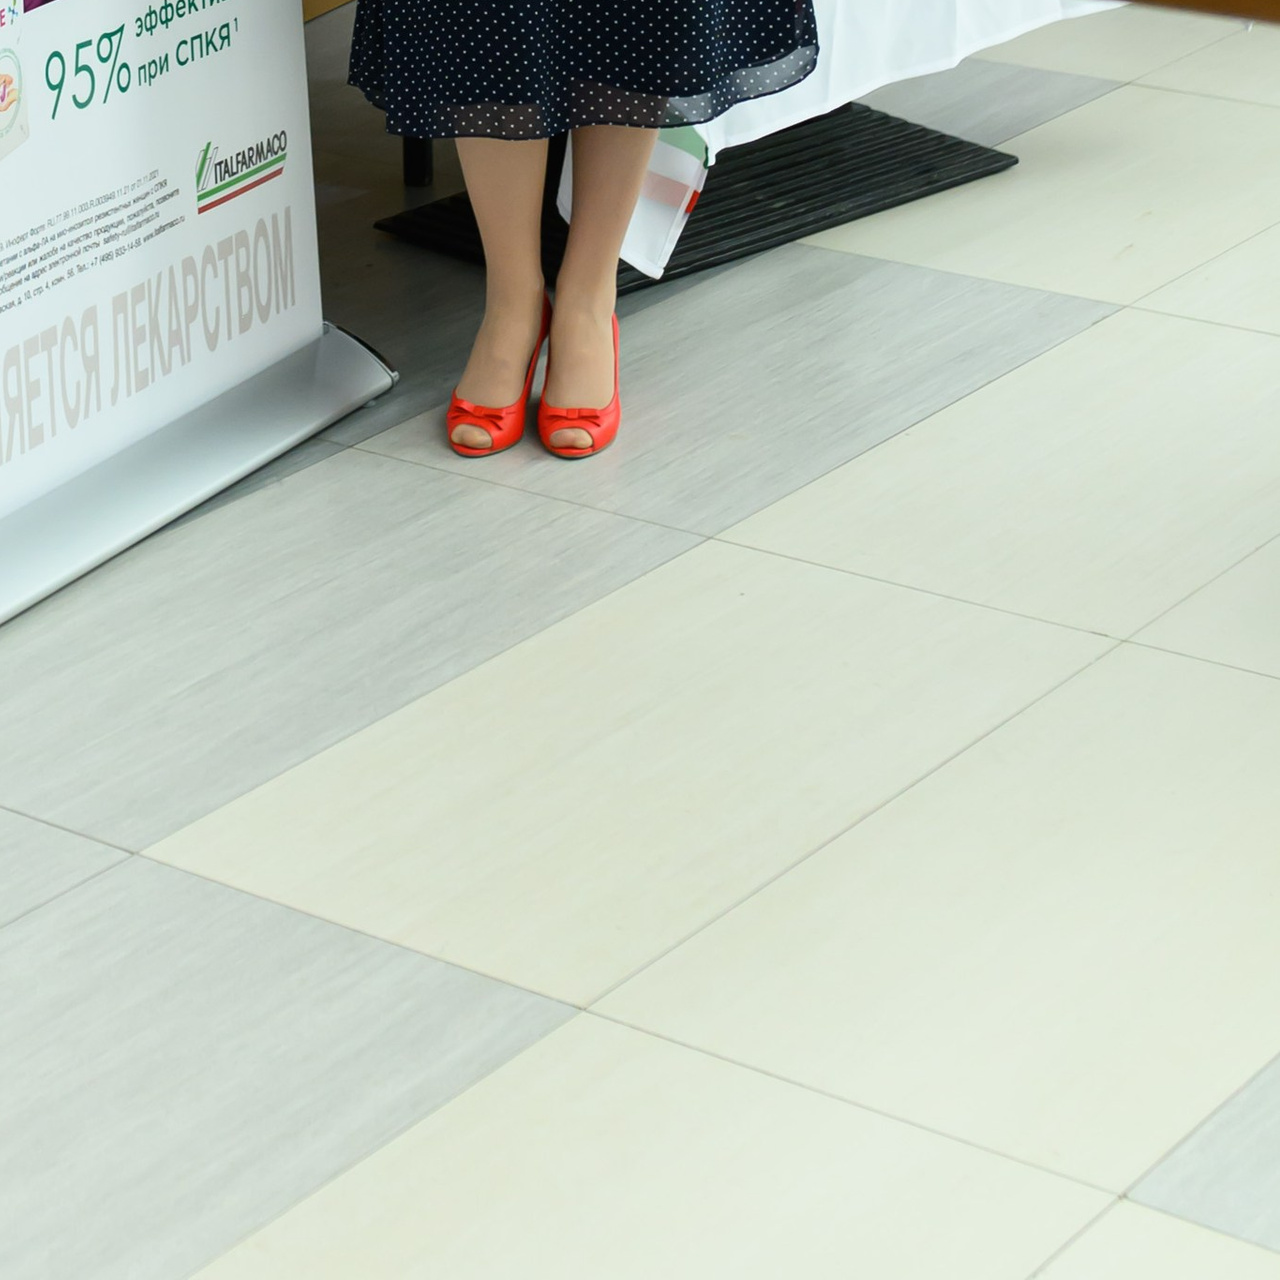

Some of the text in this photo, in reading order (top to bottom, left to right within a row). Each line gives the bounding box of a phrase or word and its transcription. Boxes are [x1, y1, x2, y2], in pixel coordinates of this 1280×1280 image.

[45, 23, 131, 120] 95%
[138, 53, 169, 87] при
[214, 130, 287, 184] ITALFARMACO
[110, 205, 297, 408] ЛЕКАРСТВОМ
